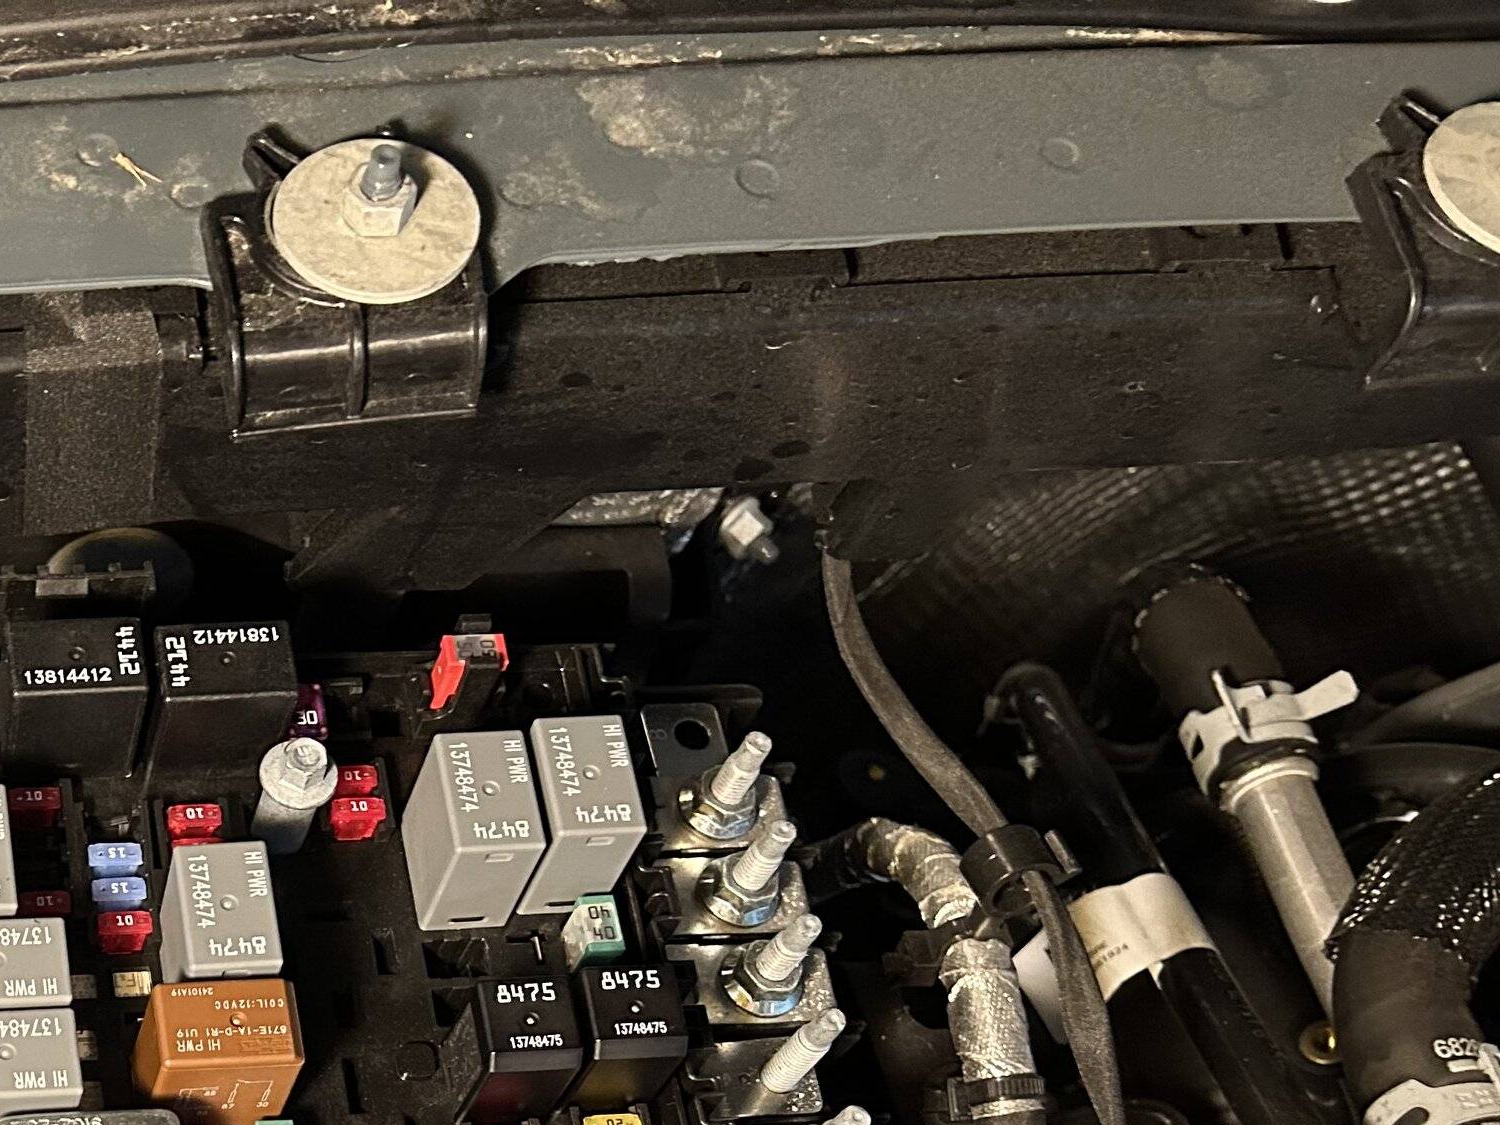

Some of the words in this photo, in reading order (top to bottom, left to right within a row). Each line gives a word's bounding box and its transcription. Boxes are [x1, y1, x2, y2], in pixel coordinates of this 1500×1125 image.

[193, 626, 280, 644] 13814412
[115, 626, 140, 676] 4412
[165, 636, 191, 688] 4412
[24, 667, 112, 684] 13814412
[602, 724, 621, 738] HI
[503, 739, 522, 752] HI
[606, 741, 629, 768] PWR
[507, 755, 528, 784] PWR
[548, 727, 581, 798] 13748474
[448, 742, 480, 812] 13748474
[186, 808, 204, 820] 10
[350, 802, 368, 812] 10
[576, 804, 632, 822] 8474
[473, 820, 530, 839] 8474
[108, 848, 126, 858] 15
[244, 851, 262, 865] HI
[111, 882, 128, 894] 15
[188, 854, 216, 929] 13748474
[247, 870, 268, 898] PWR
[116, 915, 134, 926] 10
[209, 936, 266, 956] 8474
[4, 978, 36, 997] PWR
[42, 977, 58, 995] HI
[601, 970, 661, 990] 8475
[497, 982, 556, 1004] 8475
[614, 1021, 668, 1036] 13748475
[177, 1040, 204, 1052] PWR
[208, 1040, 221, 1050] HI
[510, 1034, 564, 1049] 13748475
[14, 1070, 46, 1090] PWR
[52, 1069, 68, 1088] HI
